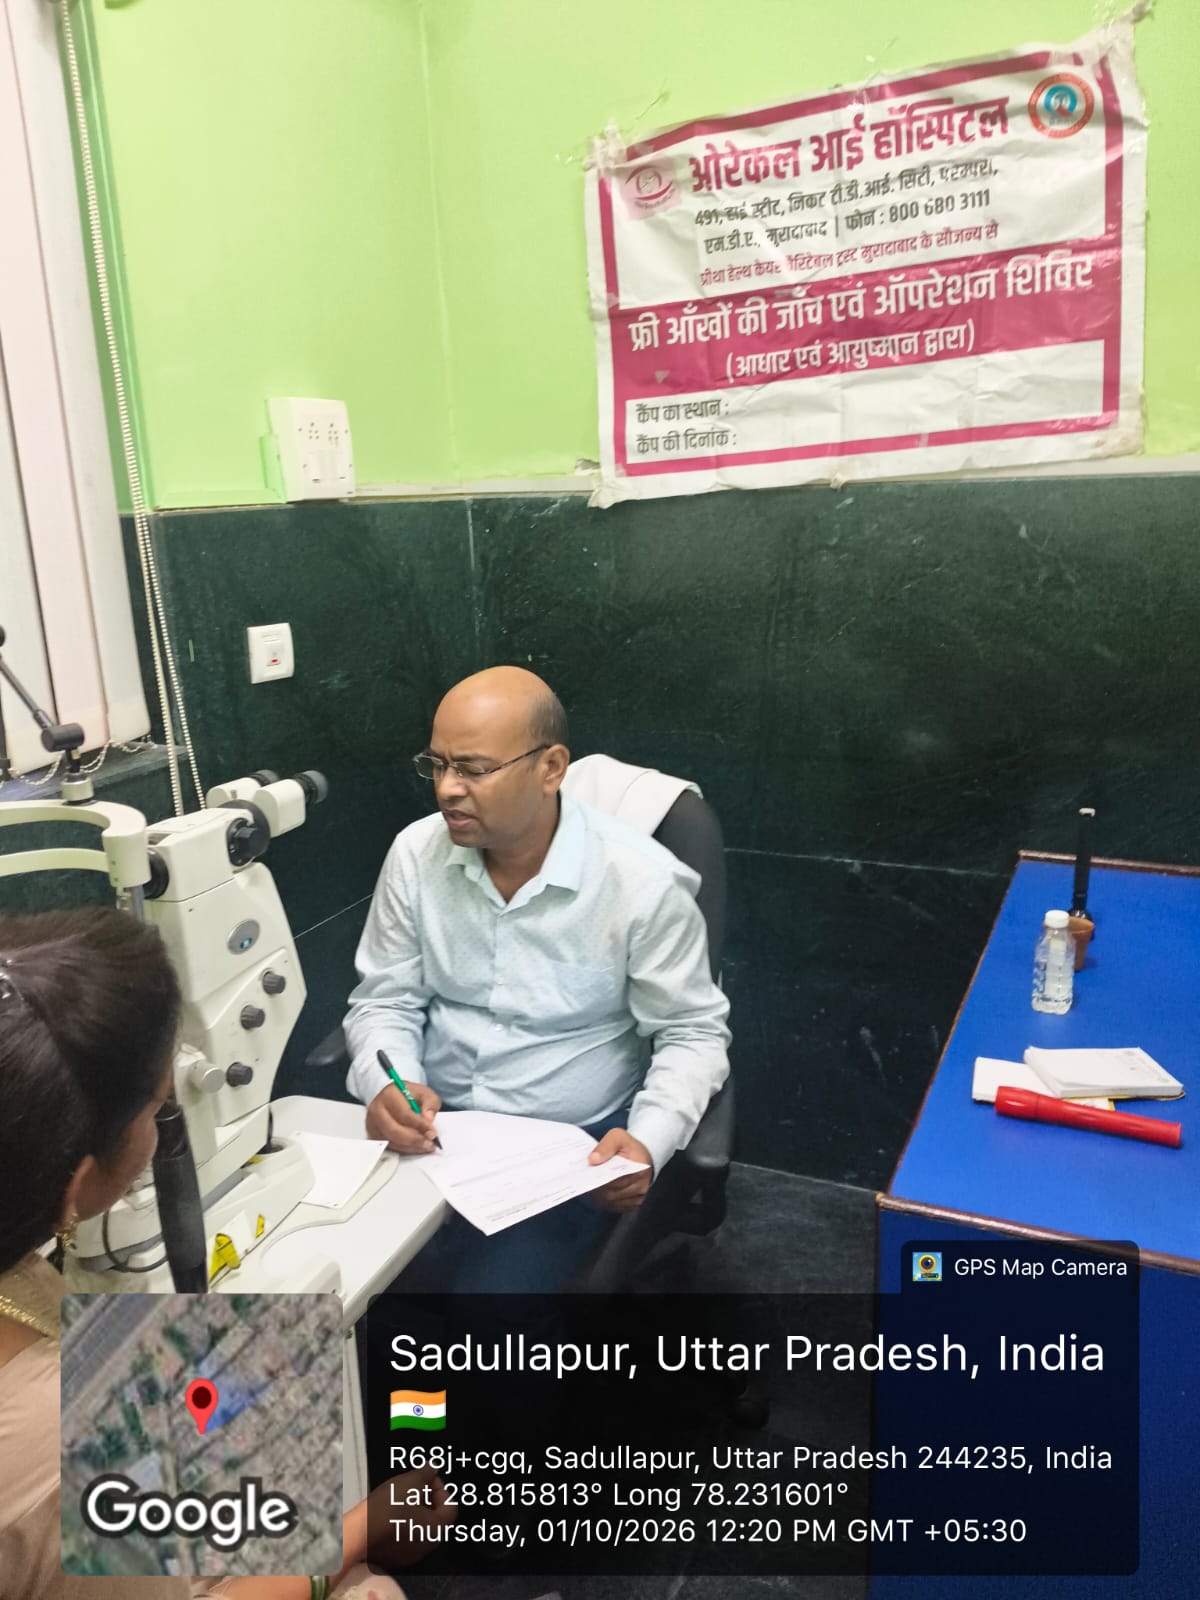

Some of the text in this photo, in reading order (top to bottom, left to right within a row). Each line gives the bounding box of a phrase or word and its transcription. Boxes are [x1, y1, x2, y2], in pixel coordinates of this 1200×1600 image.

[688, 138, 802, 192] ओरेकल
[809, 112, 866, 171] आई
[870, 96, 1009, 161] हॉस्पिटल
[787, 191, 827, 213] निकट
[898, 164, 936, 191] सिटी,
[845, 209, 876, 231] फोन
[889, 201, 919, 223] 800
[924, 194, 955, 217] 680
[960, 188, 991, 211] 3111
[860, 235, 917, 264] मुरादाबाद
[920, 230, 933, 250] के
[935, 224, 982, 248] सौजन्य
[985, 219, 999, 239] से
[628, 311, 660, 351] फ्री
[666, 302, 733, 344] आँखों
[735, 296, 769, 336] की
[827, 281, 866, 322] एवं
[873, 267, 1000, 317] ऑपरेशन
[1004, 249, 1096, 298] शिविर
[726, 318, 975, 384] (आधार एवं आयुष्मान द्वारा)
[663, 403, 682, 421] का
[682, 399, 722, 420] स्थान
[663, 430, 682, 451] की
[684, 428, 731, 450] दिनांक
